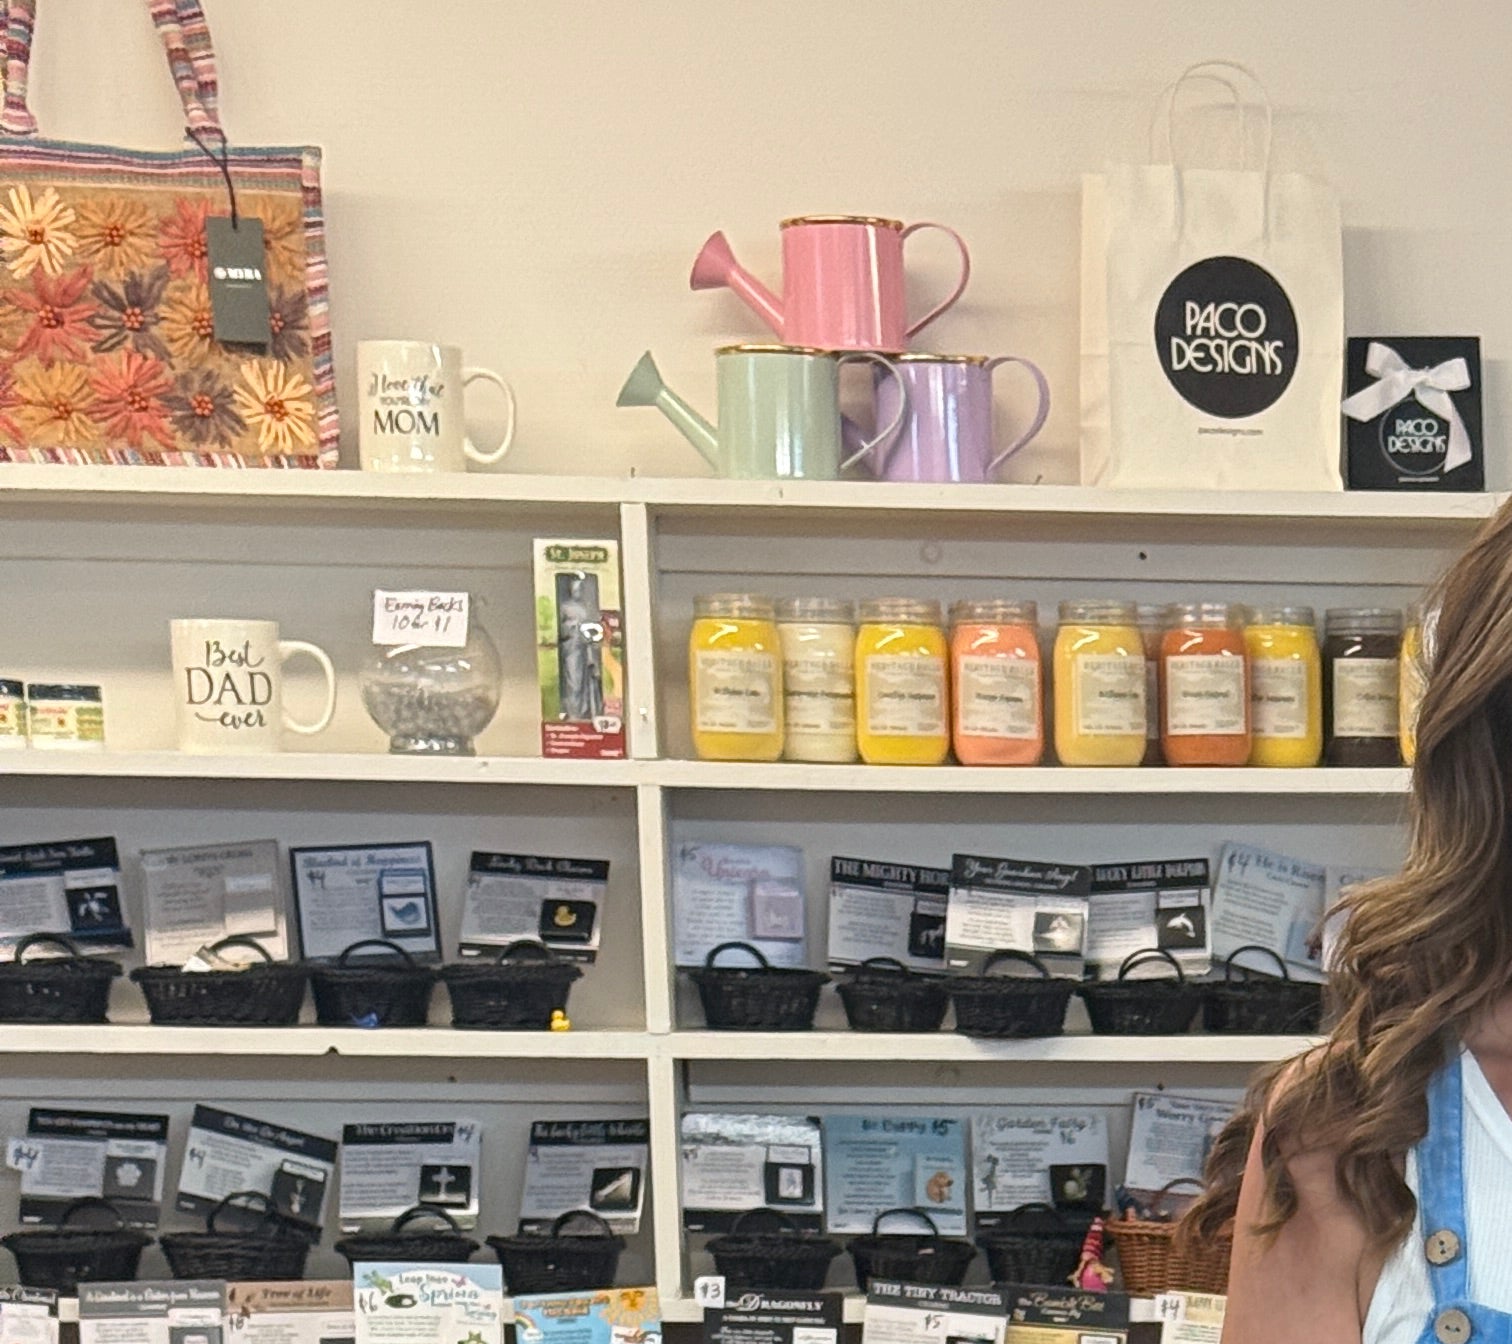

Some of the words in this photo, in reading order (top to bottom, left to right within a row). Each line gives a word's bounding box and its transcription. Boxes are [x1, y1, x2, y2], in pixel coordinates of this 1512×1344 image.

[1185, 301, 1267, 339] PACO
[1171, 336, 1284, 375] DESIGNS
[373, 410, 440, 436] MOM
[1395, 419, 1439, 436] PACO
[1387, 435, 1447, 453] DESIGNS
[204, 640, 265, 667] Best
[184, 666, 273, 706] DAD
[194, 709, 267, 729] ever
[861, 862, 917, 884] MIGHTY
[919, 868, 950, 887] HOR
[873, 1282, 901, 1296] THE
[903, 1285, 937, 1300] TINY
[940, 1288, 1002, 1306] TRACTOR
